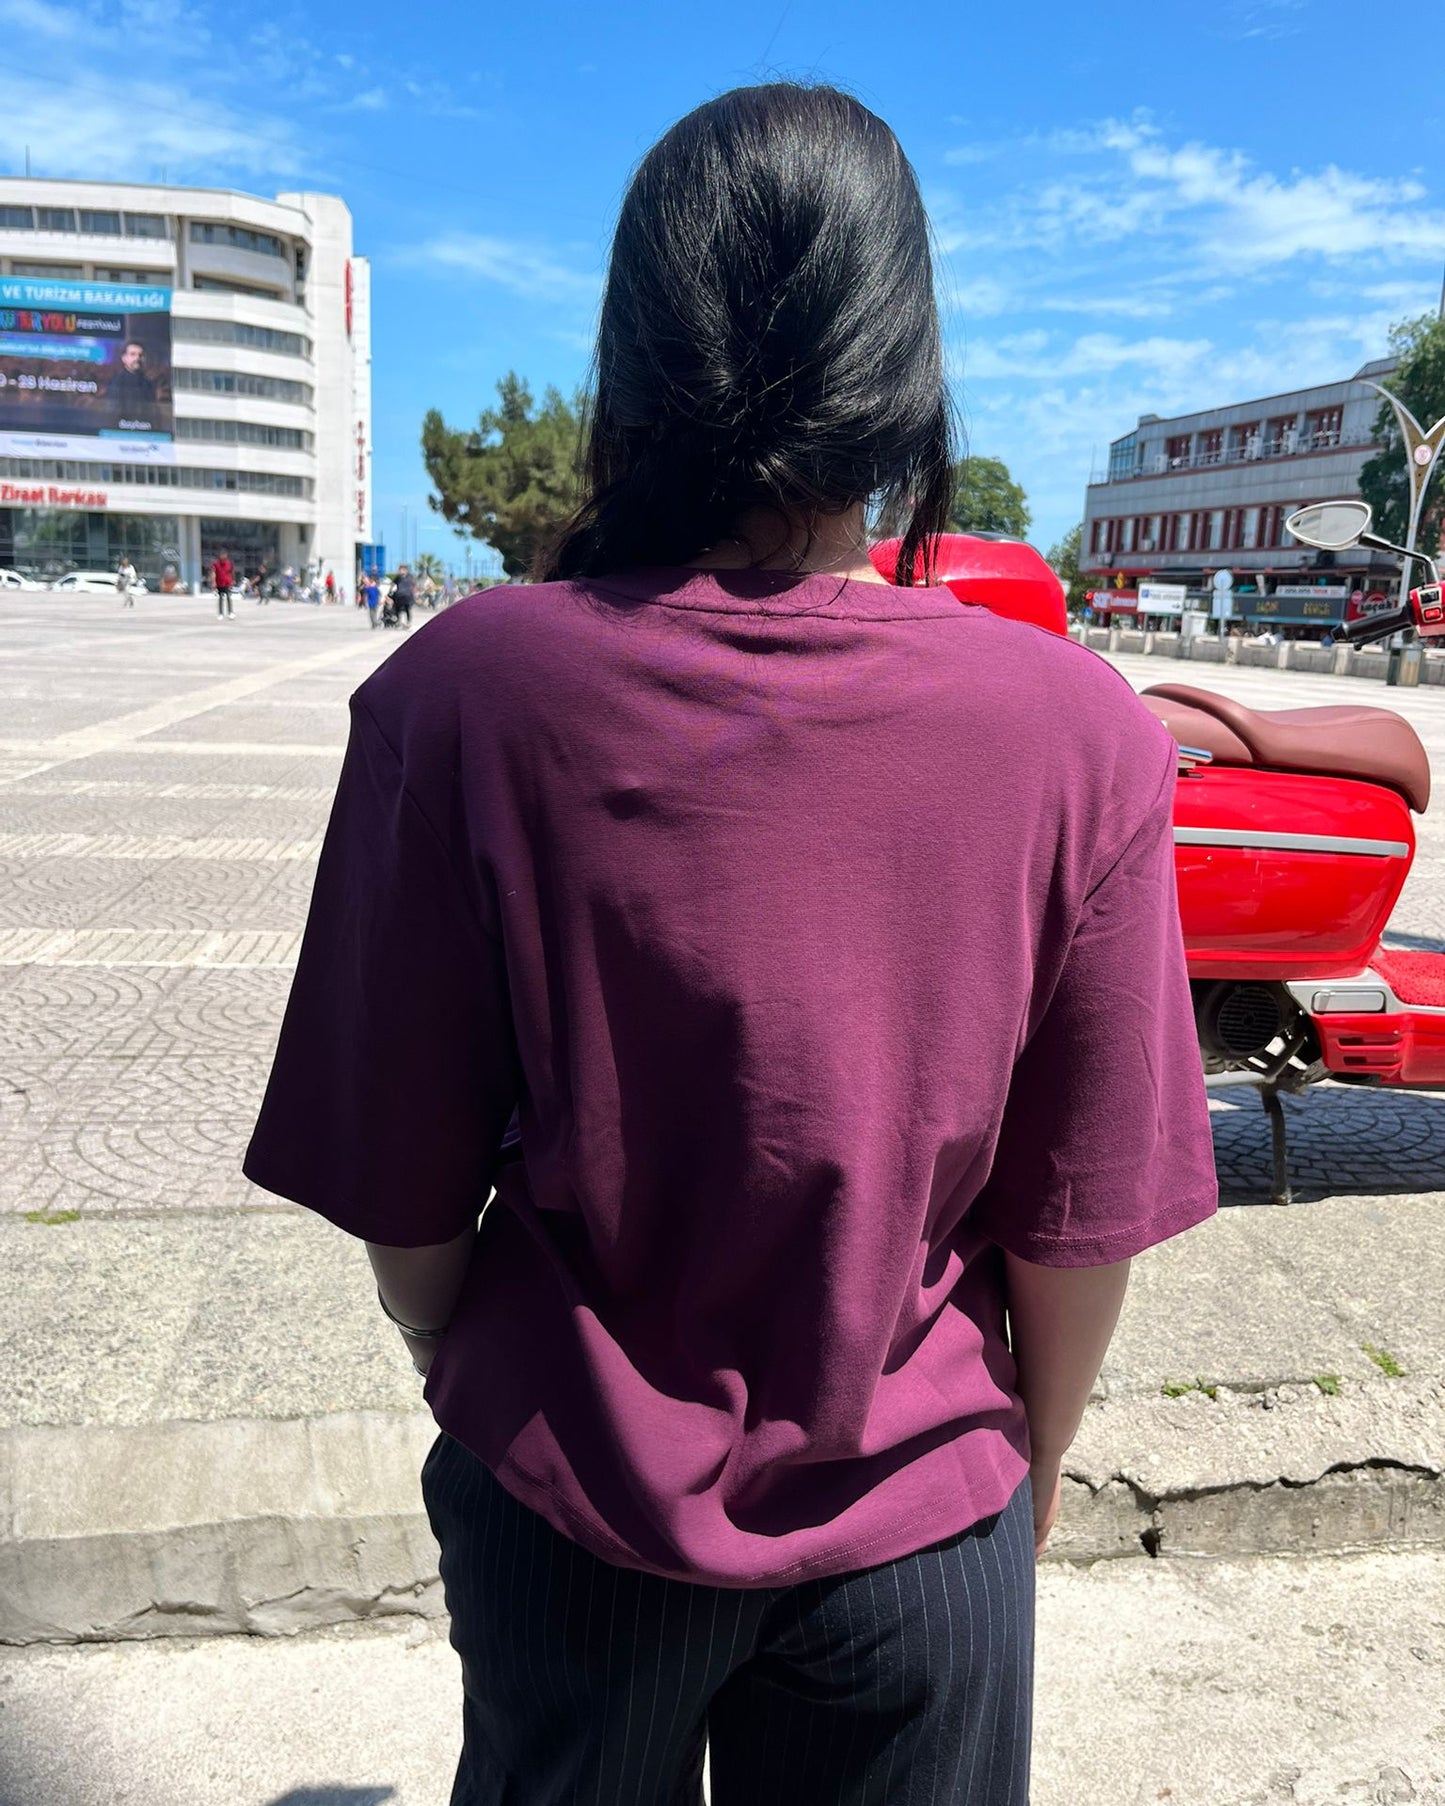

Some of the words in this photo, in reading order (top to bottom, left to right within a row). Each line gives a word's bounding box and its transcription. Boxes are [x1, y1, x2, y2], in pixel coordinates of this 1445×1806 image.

[2, 284, 21, 299] VE
[24, 285, 81, 303] TURİZM
[84, 289, 165, 308] BAKANLIĞI
[38, 375, 98, 394] Haziran
[1, 484, 45, 502] Ziraat
[48, 487, 108, 507] Bankası
